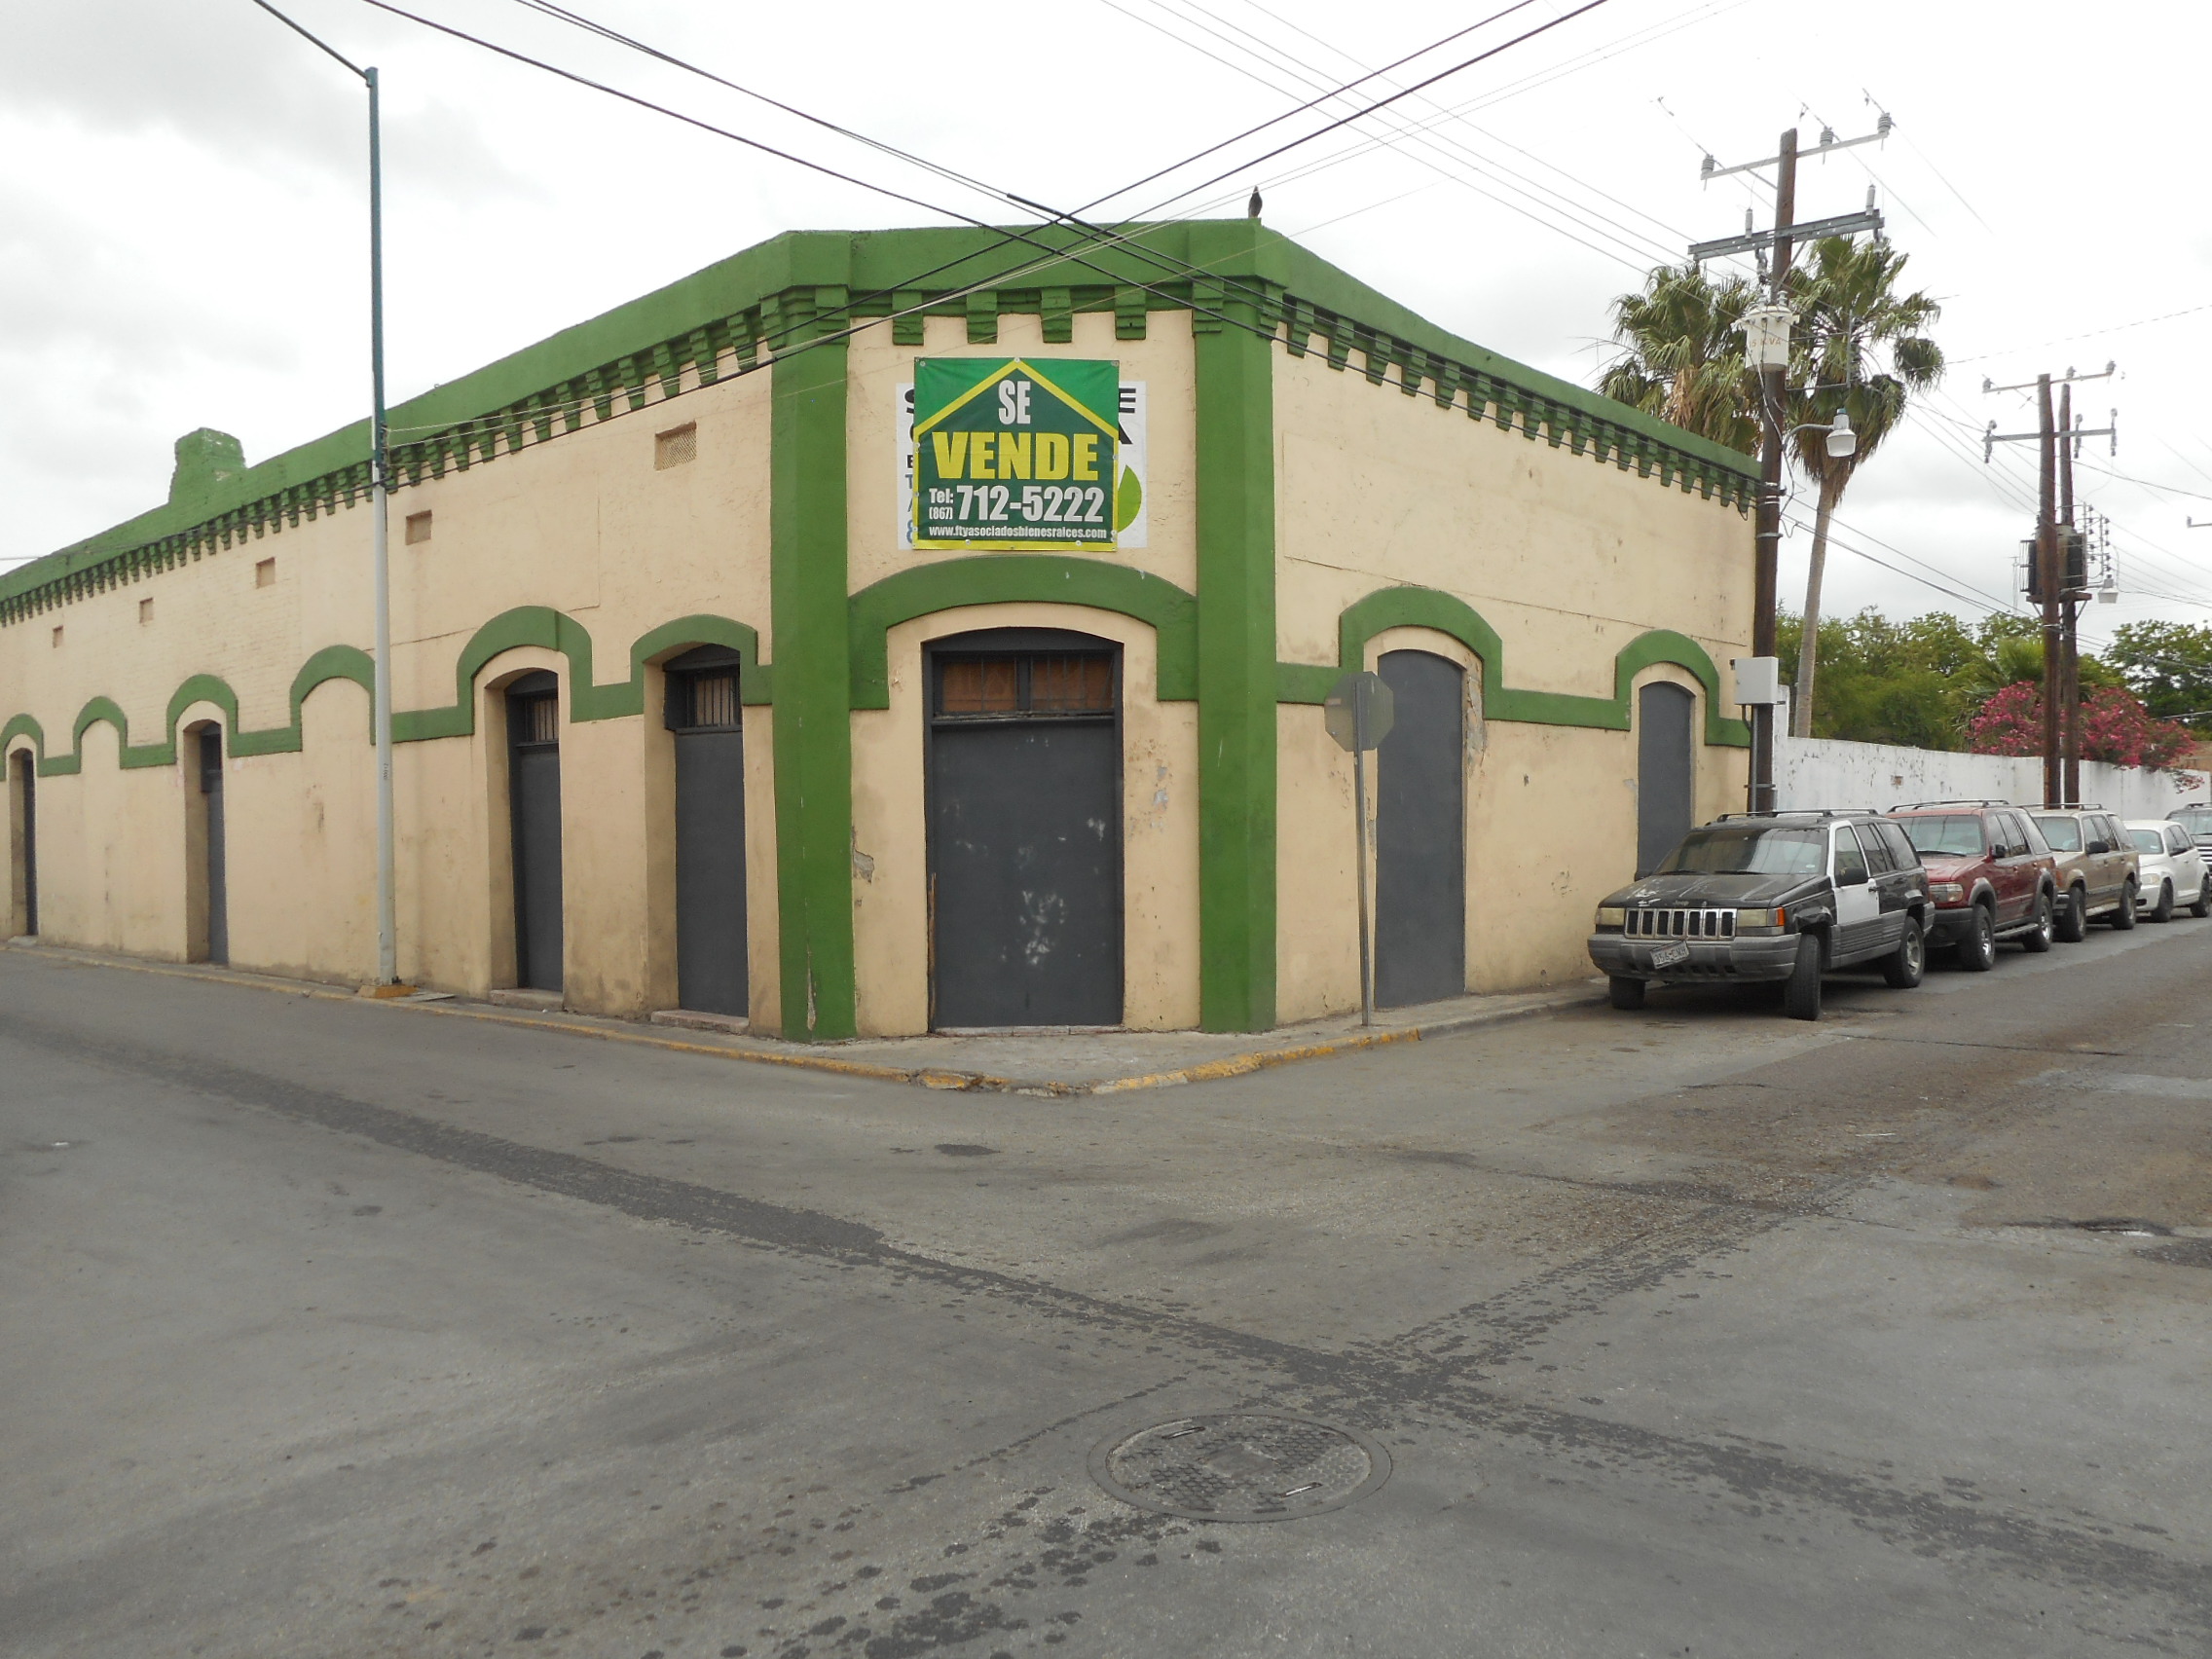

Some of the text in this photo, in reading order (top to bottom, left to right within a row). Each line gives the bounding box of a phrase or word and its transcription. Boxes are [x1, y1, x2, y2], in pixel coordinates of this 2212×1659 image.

[999, 379, 1031, 425] SE
[932, 431, 1098, 481] VENDE
[929, 485, 1105, 523] Tel: 712-5222
[929, 506, 953, 520] (867)
